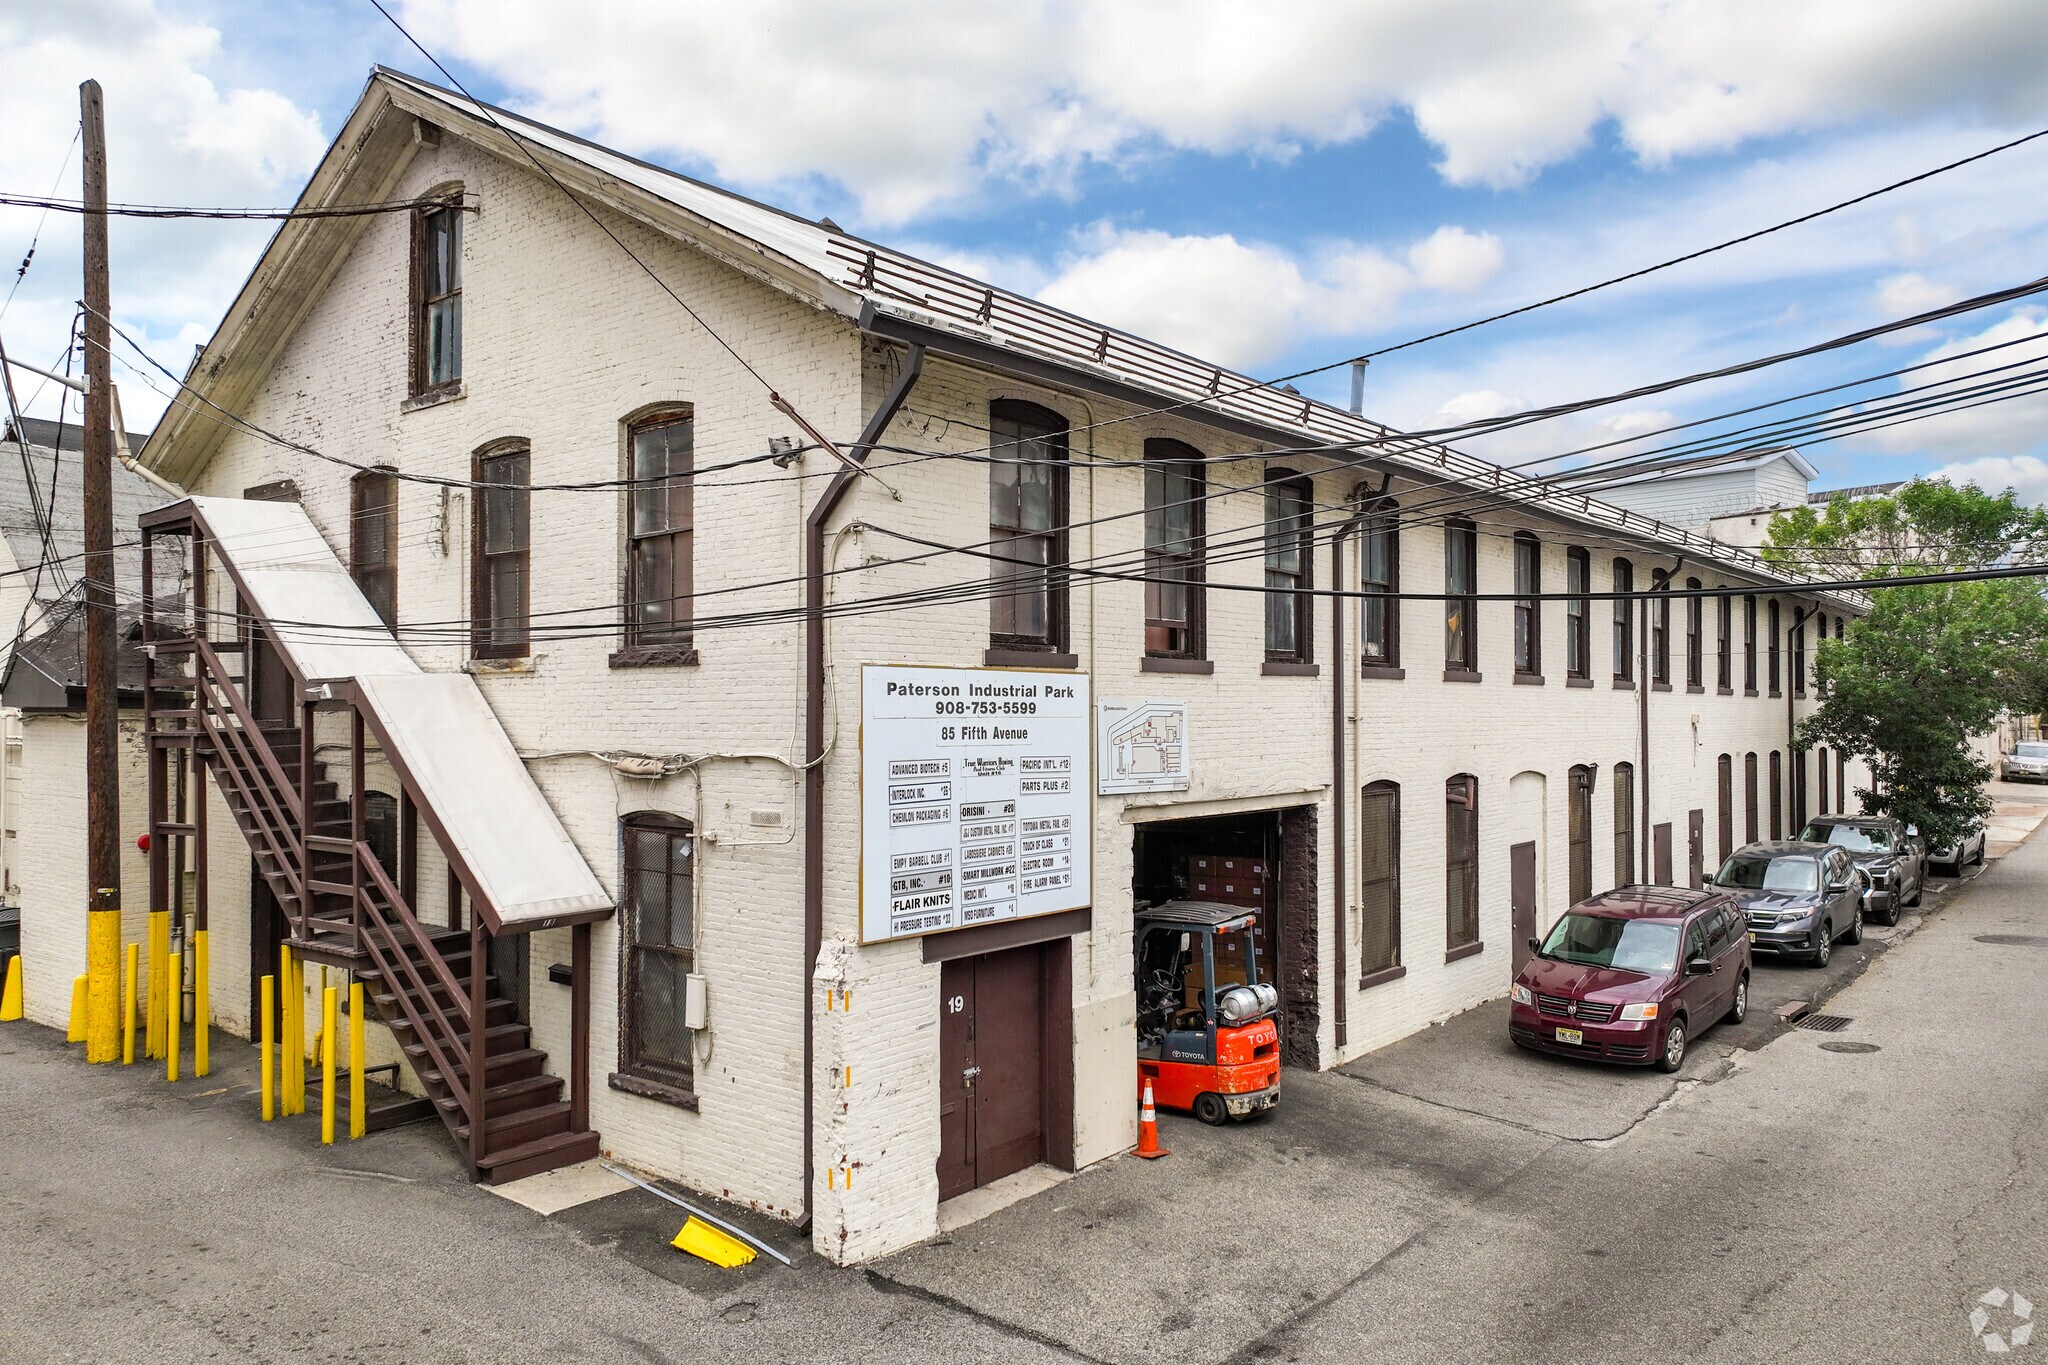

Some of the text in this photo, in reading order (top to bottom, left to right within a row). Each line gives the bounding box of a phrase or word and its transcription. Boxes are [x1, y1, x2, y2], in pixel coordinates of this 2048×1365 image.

[887, 682, 1074, 698] Paterson Industrial Park
[935, 701, 1037, 715] 908-753-5599
[942, 726, 1028, 740] 85 Fifth Avenue
[892, 762, 948, 775] ADVANCED BIOTECH #5
[964, 757, 1014, 767] True Warriors Boxing
[1022, 760, 1041, 770] PACIFIC
[1060, 760, 1068, 768] #12
[1022, 780, 1068, 791] PARTS PLUS #2
[892, 788, 916, 800] INTERLOCK
[893, 812, 914, 823] CHEMLON
[916, 810, 940, 821] PACKAGING
[962, 804, 1014, 816] ORISINI #20
[1040, 820, 1051, 830] METAL
[1023, 841, 1035, 851] TOUCH
[1036, 840, 1040, 850] OF
[1042, 838, 1053, 849] CLASS
[909, 855, 929, 867] BARBELL
[931, 854, 942, 864] CLUB
[944, 853, 950, 862] #1
[1023, 859, 1040, 870] ELECTRIC
[1043, 858, 1054, 867] ROOM
[963, 864, 1014, 880] SMART MILLWORK #22
[893, 874, 950, 891] GTB, INC. #10
[1024, 880, 1032, 890] FIRE
[1035, 877, 1047, 888] ALARM
[1049, 876, 1061, 885] PANEL
[894, 894, 950, 912] FLAIR KNITS
[974, 906, 994, 919] FURNITURE
[894, 922, 899, 932] HI
[900, 918, 922, 932] PRESSURE
[924, 915, 941, 927] TESTING
[948, 996, 964, 1014] 19
[1182, 1051, 1205, 1060] TOYOTA
